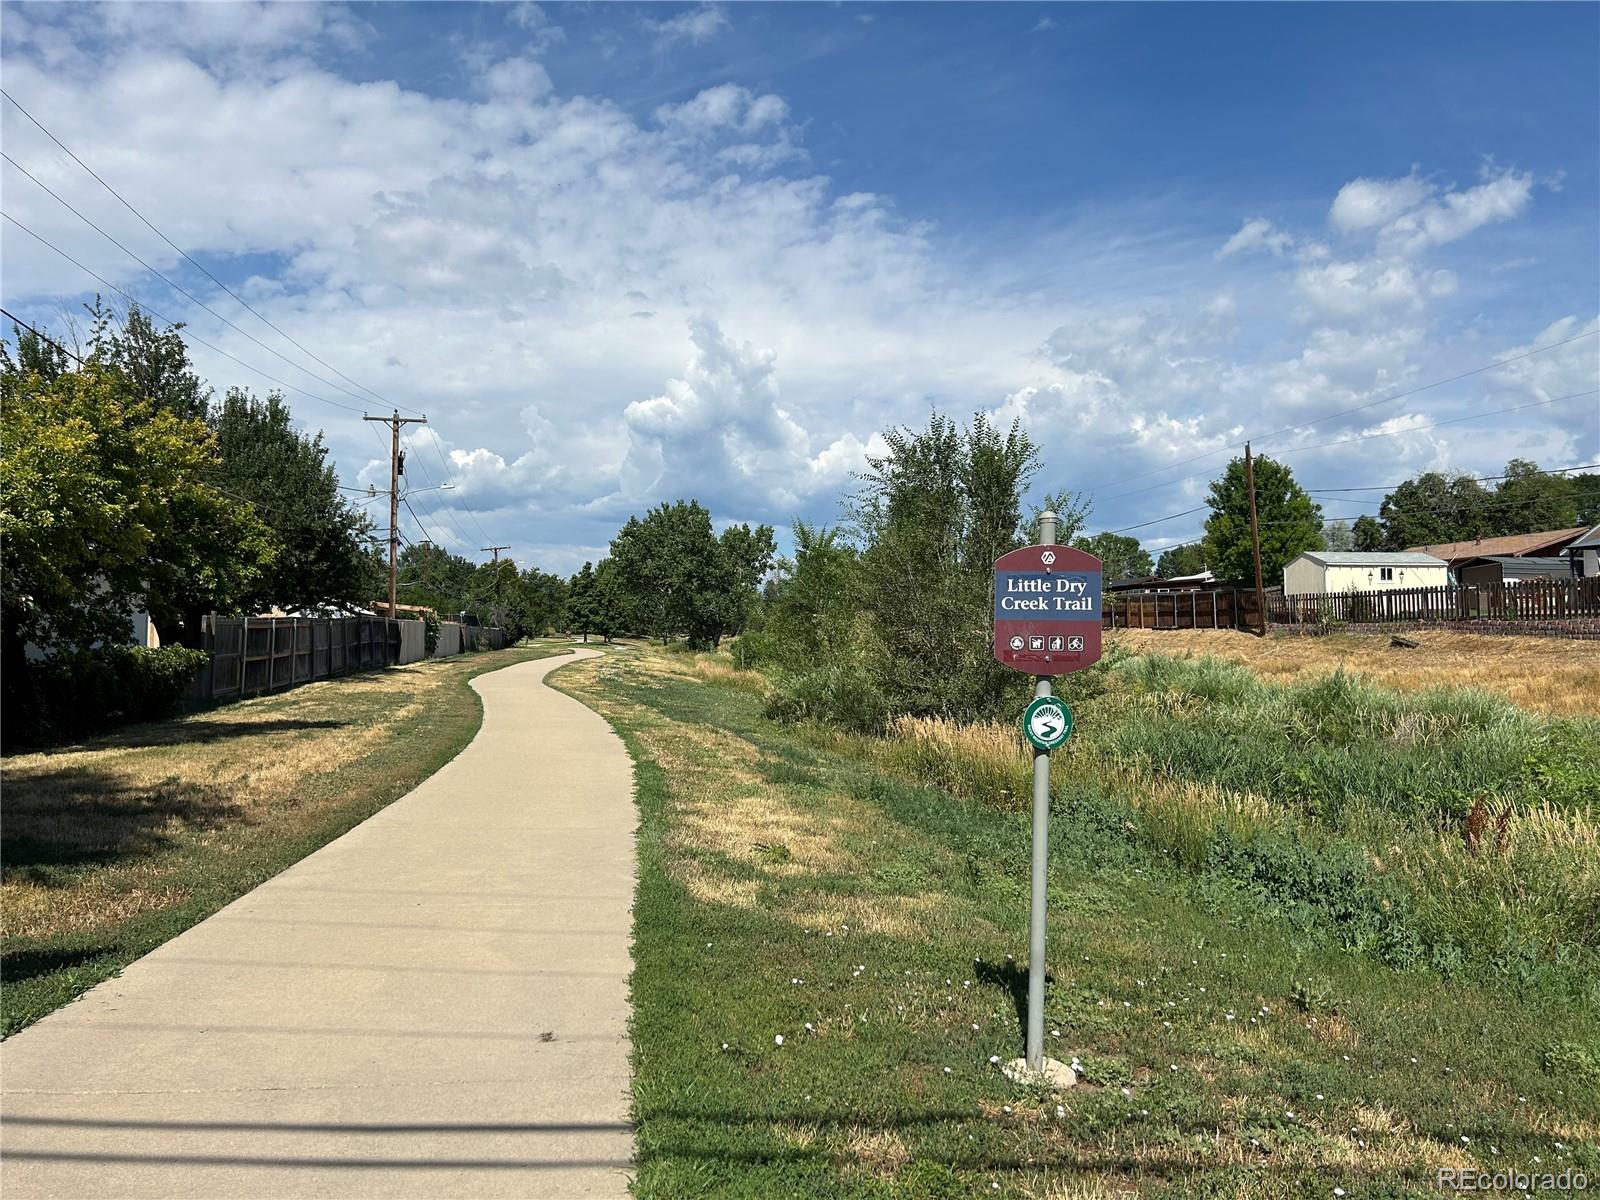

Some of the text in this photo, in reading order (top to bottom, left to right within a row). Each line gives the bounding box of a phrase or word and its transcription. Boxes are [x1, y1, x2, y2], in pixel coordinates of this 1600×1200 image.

[1007, 579, 1087, 596] Little Dry
[1001, 597, 1093, 611] Creek Trail
